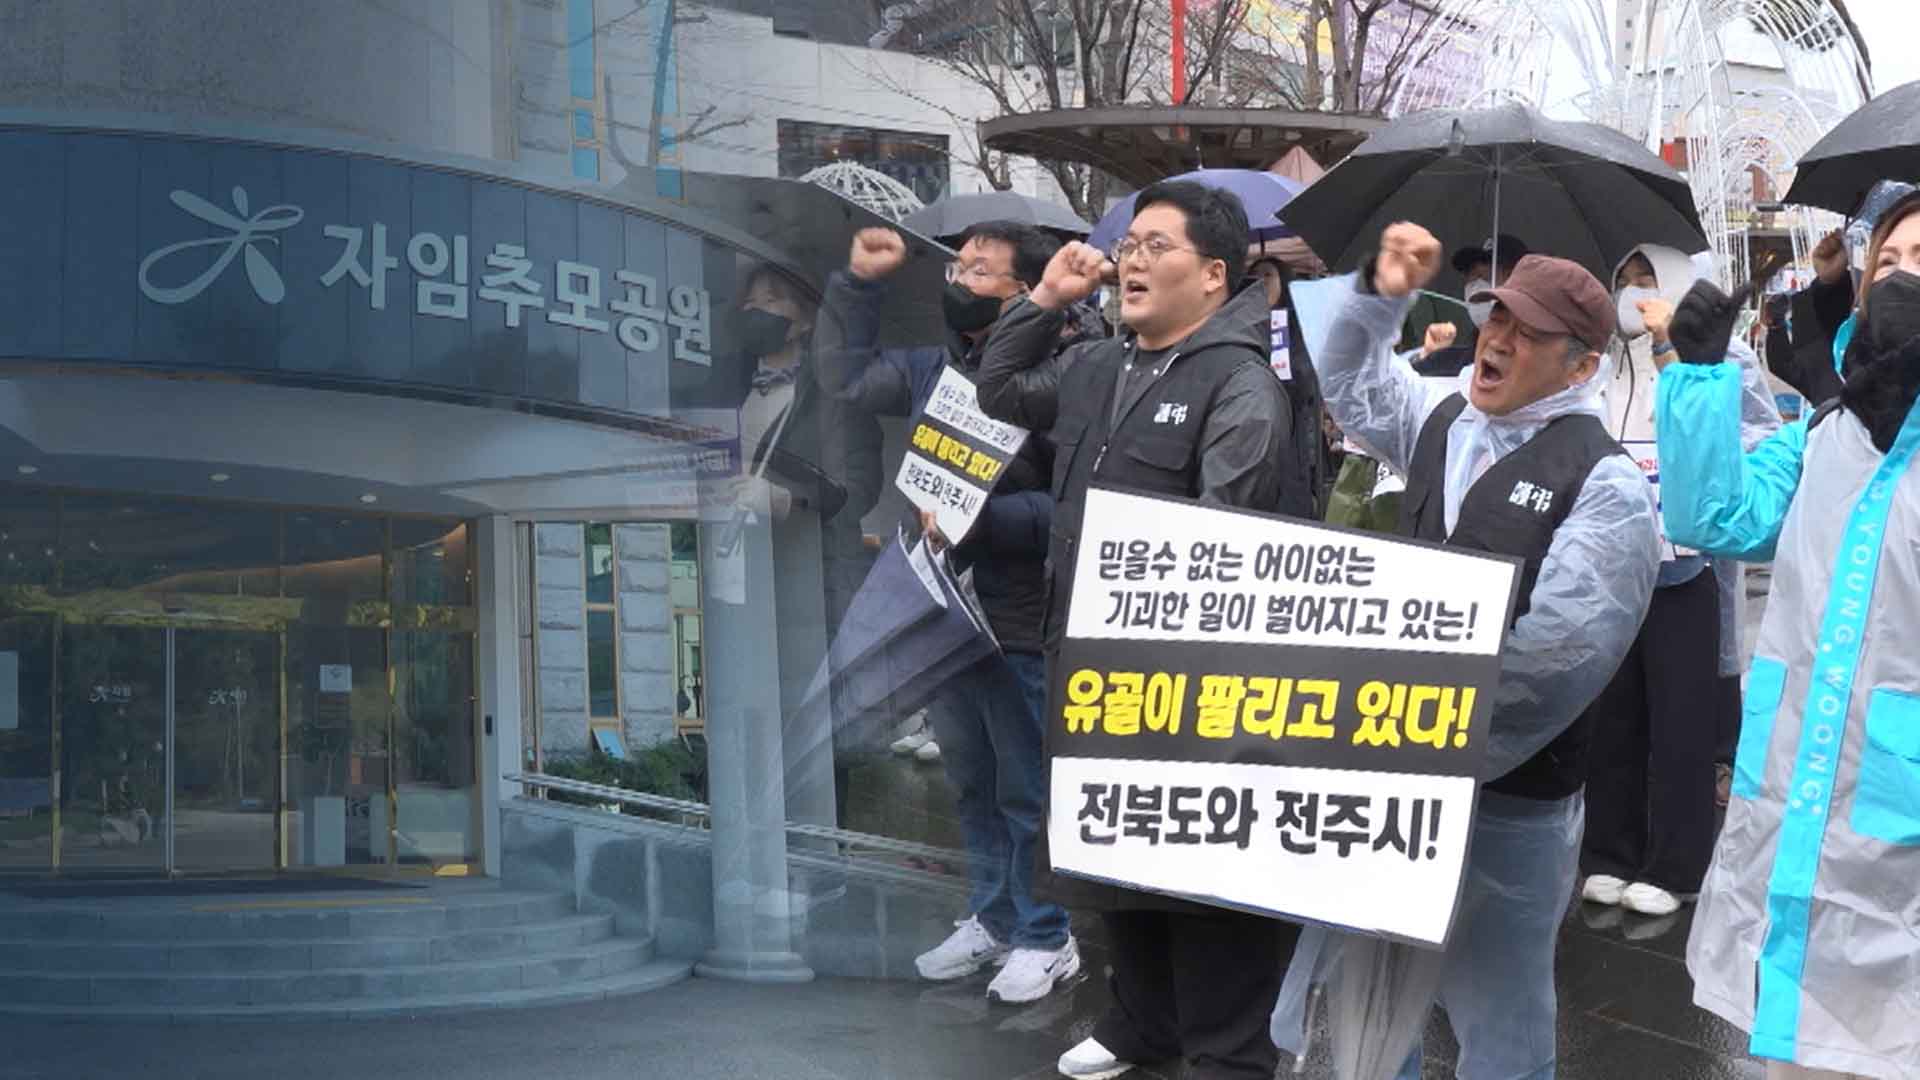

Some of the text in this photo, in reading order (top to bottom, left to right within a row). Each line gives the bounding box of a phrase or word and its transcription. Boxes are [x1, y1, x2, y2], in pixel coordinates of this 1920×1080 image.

[319, 222, 712, 367] 자임추모공원
[1099, 540, 1376, 587] 믿을수 없는 어이없는
[1105, 590, 1479, 643] 기괴한 일이 벌어지고 있는!
[1063, 668, 1478, 749] 유골이 팔리고 있다!
[1076, 782, 1443, 862] 전북도와 전주시!
